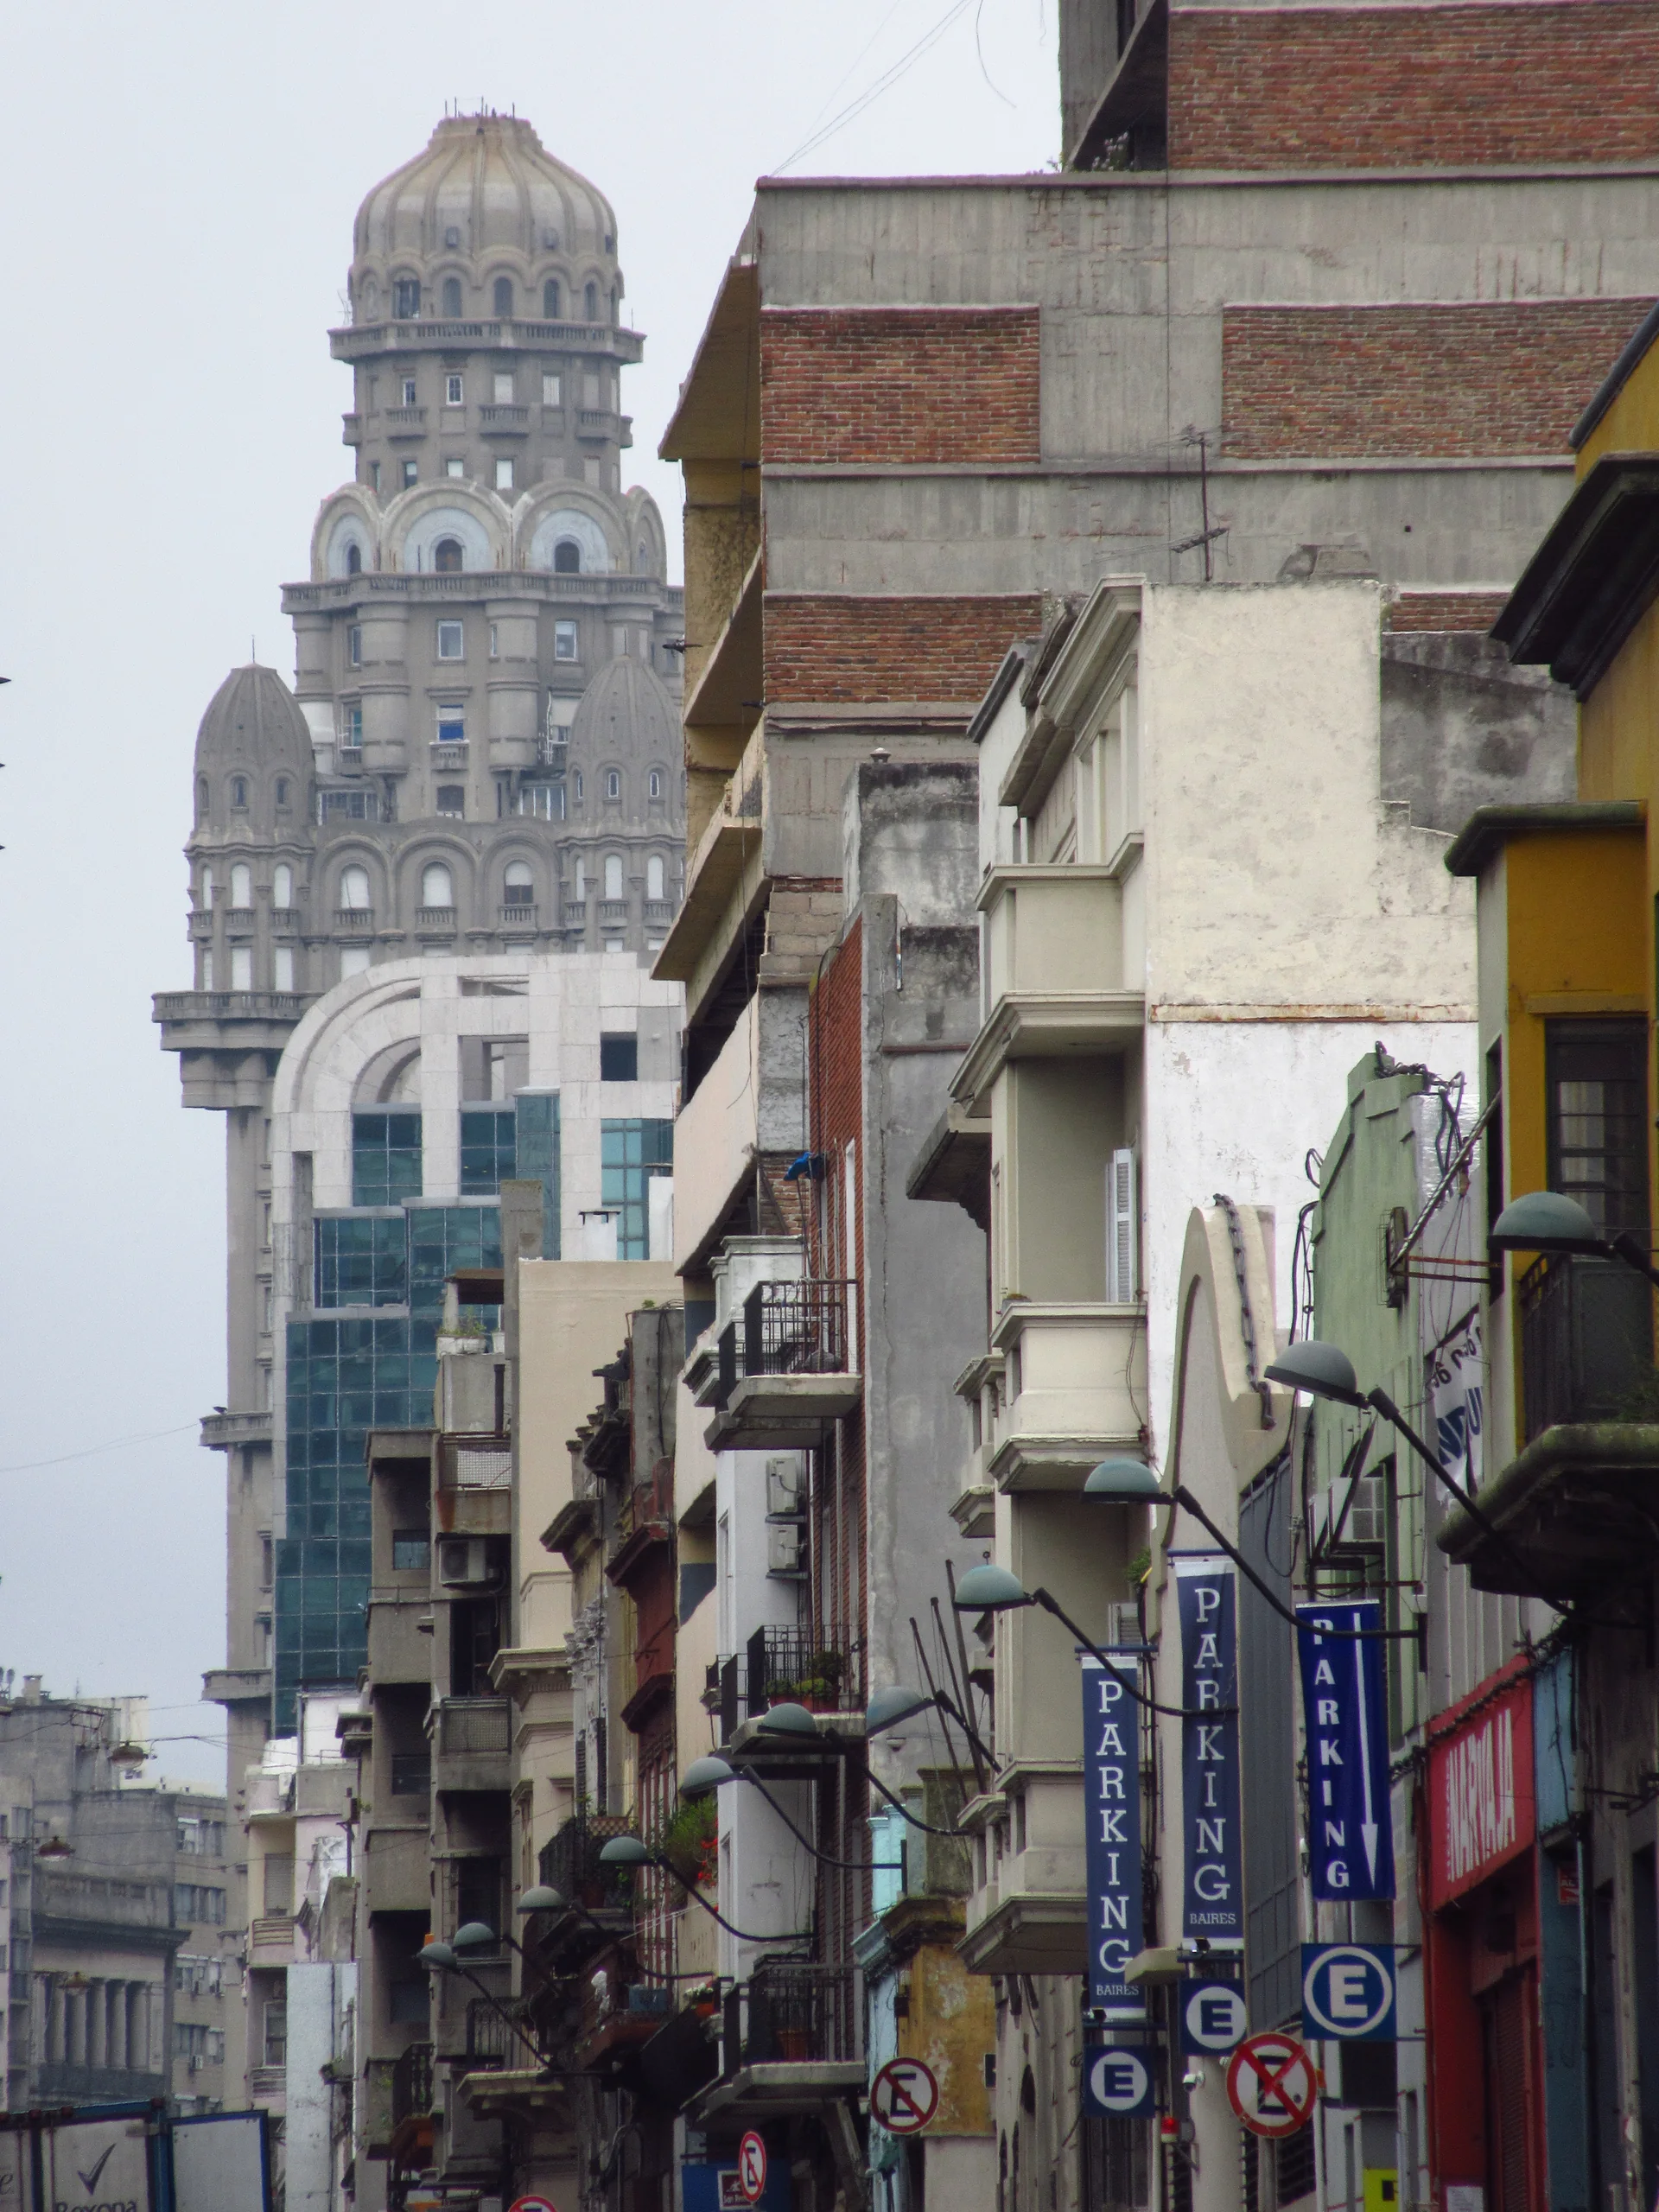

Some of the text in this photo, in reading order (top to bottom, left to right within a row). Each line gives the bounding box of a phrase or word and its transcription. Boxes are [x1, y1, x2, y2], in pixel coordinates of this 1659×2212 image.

[1193, 1588, 1230, 1901] PARKING
[1313, 1619, 1349, 1888] PARKING
[1096, 1681, 1134, 1973] PARKING
[1190, 1912, 1236, 1925] BAIRES
[1096, 1984, 1140, 1996] BAIRES
[1329, 1964, 1369, 2018] E
[1201, 1999, 1234, 2036] E
[890, 2073, 917, 2117] E
[1103, 2063, 1134, 2098] E
